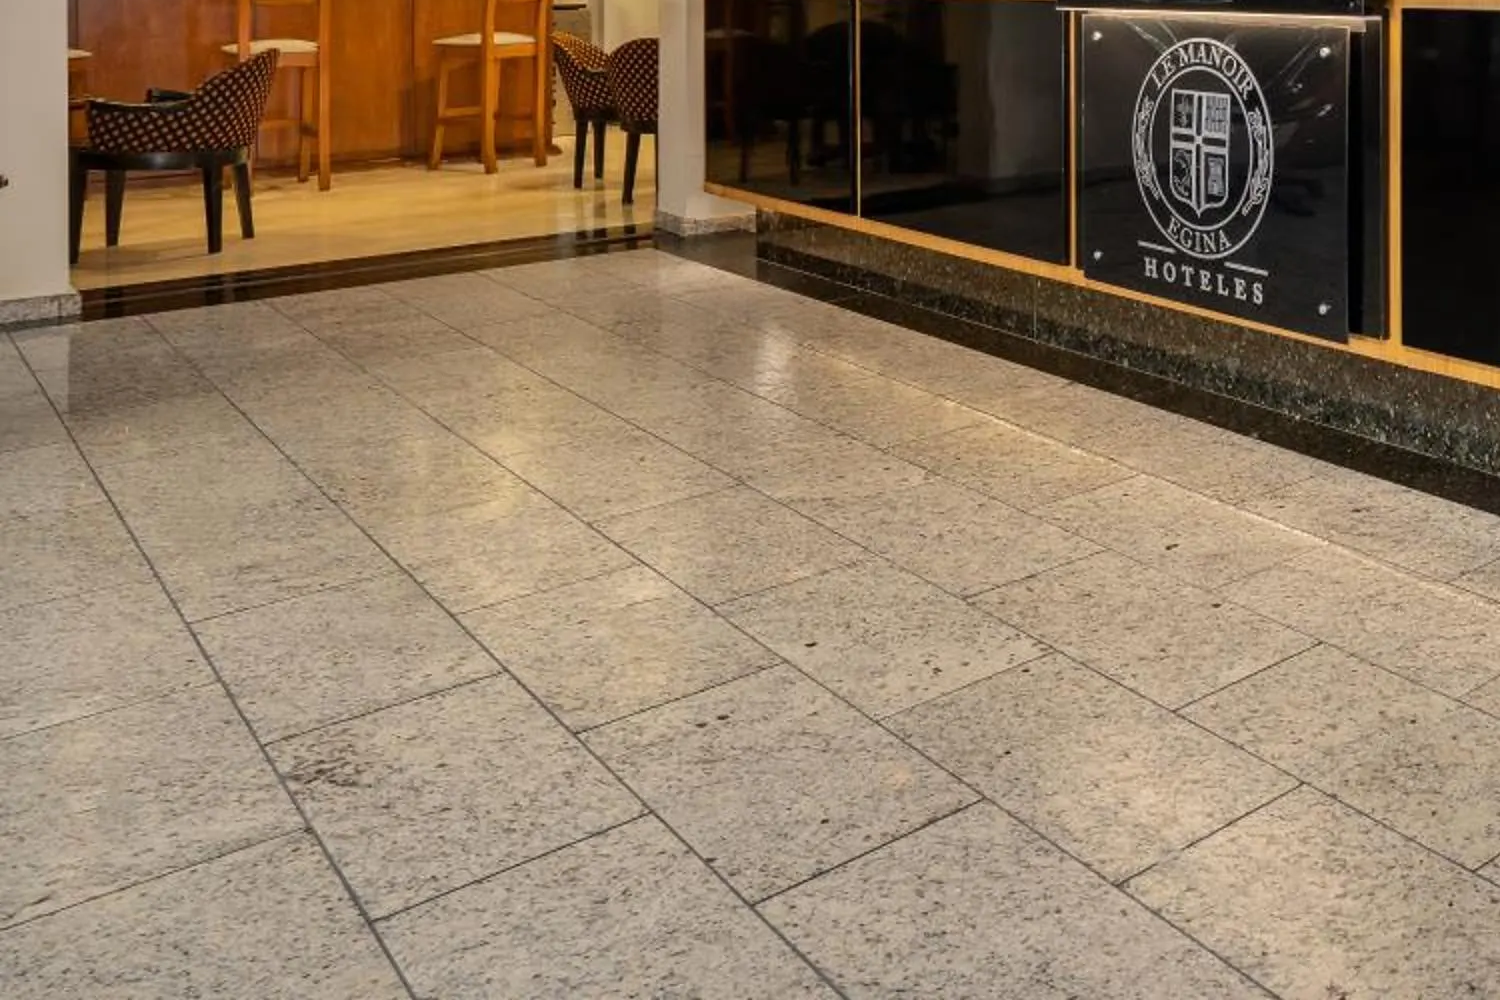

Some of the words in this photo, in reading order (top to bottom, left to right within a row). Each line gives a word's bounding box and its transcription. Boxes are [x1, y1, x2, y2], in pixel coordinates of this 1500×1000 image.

[1151, 55, 1177, 90] LE
[1178, 43, 1254, 101] MANOIR
[1167, 216, 1233, 253] EGINA
[1143, 256, 1264, 305] HOTELES
